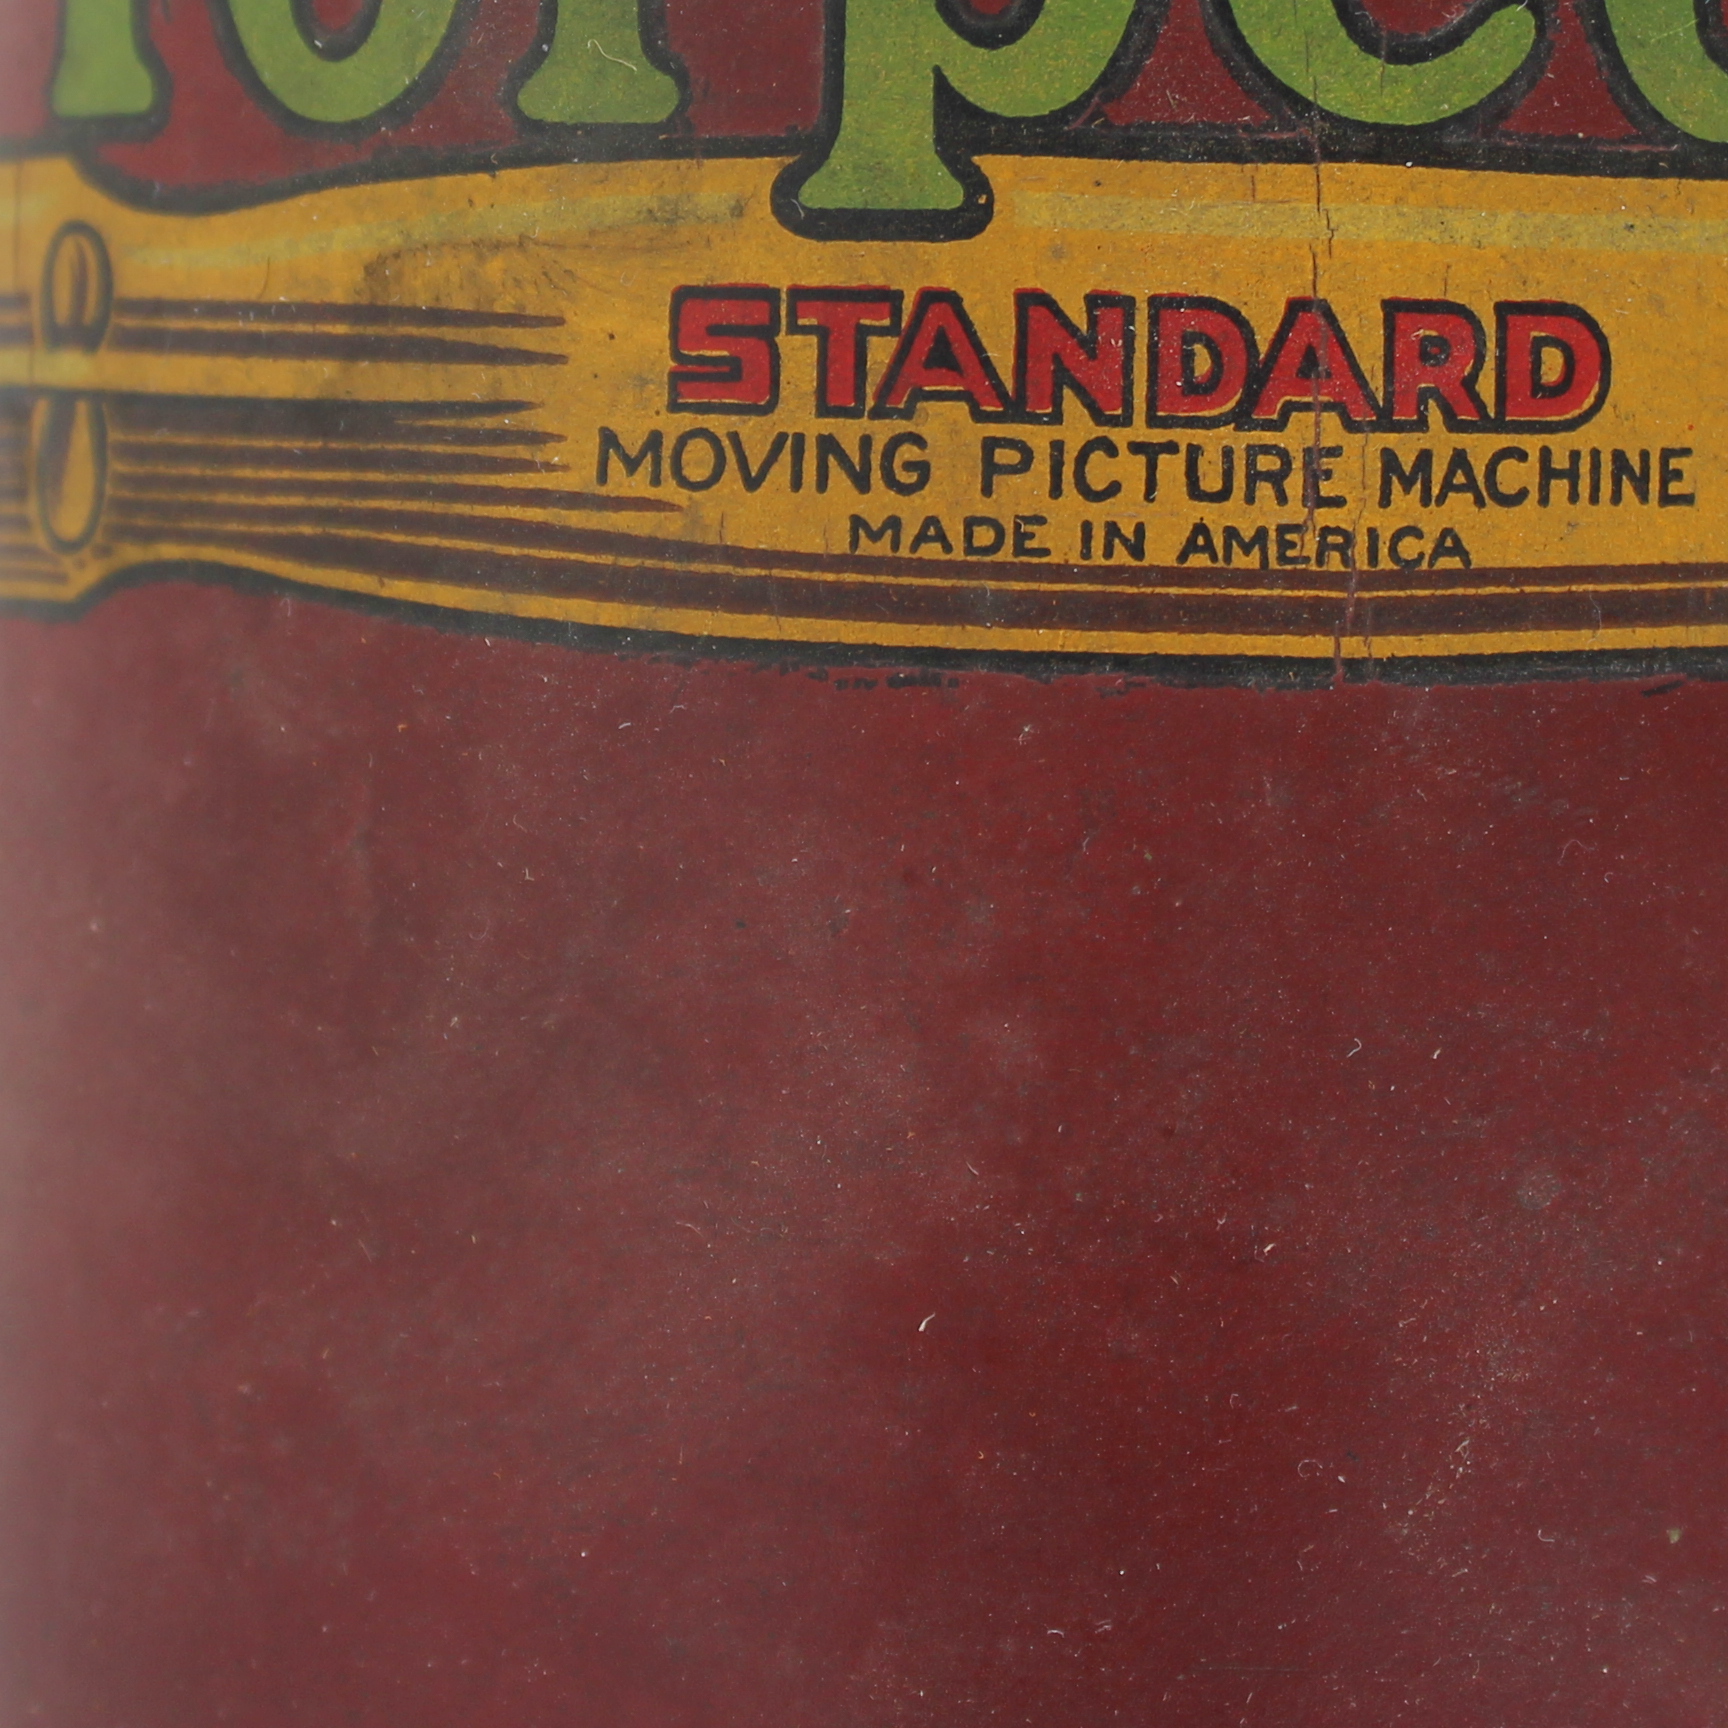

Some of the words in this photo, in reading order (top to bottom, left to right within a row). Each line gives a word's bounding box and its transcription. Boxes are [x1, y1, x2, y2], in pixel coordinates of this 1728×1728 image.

[667, 283, 1612, 434] STANDARD
[595, 426, 931, 496] MOVING
[980, 435, 1348, 508] PICTURE
[1378, 445, 1696, 508] MACHINE
[849, 514, 1051, 557] MADE
[1079, 519, 1146, 562] IN
[1176, 518, 1471, 569] AMERICA
